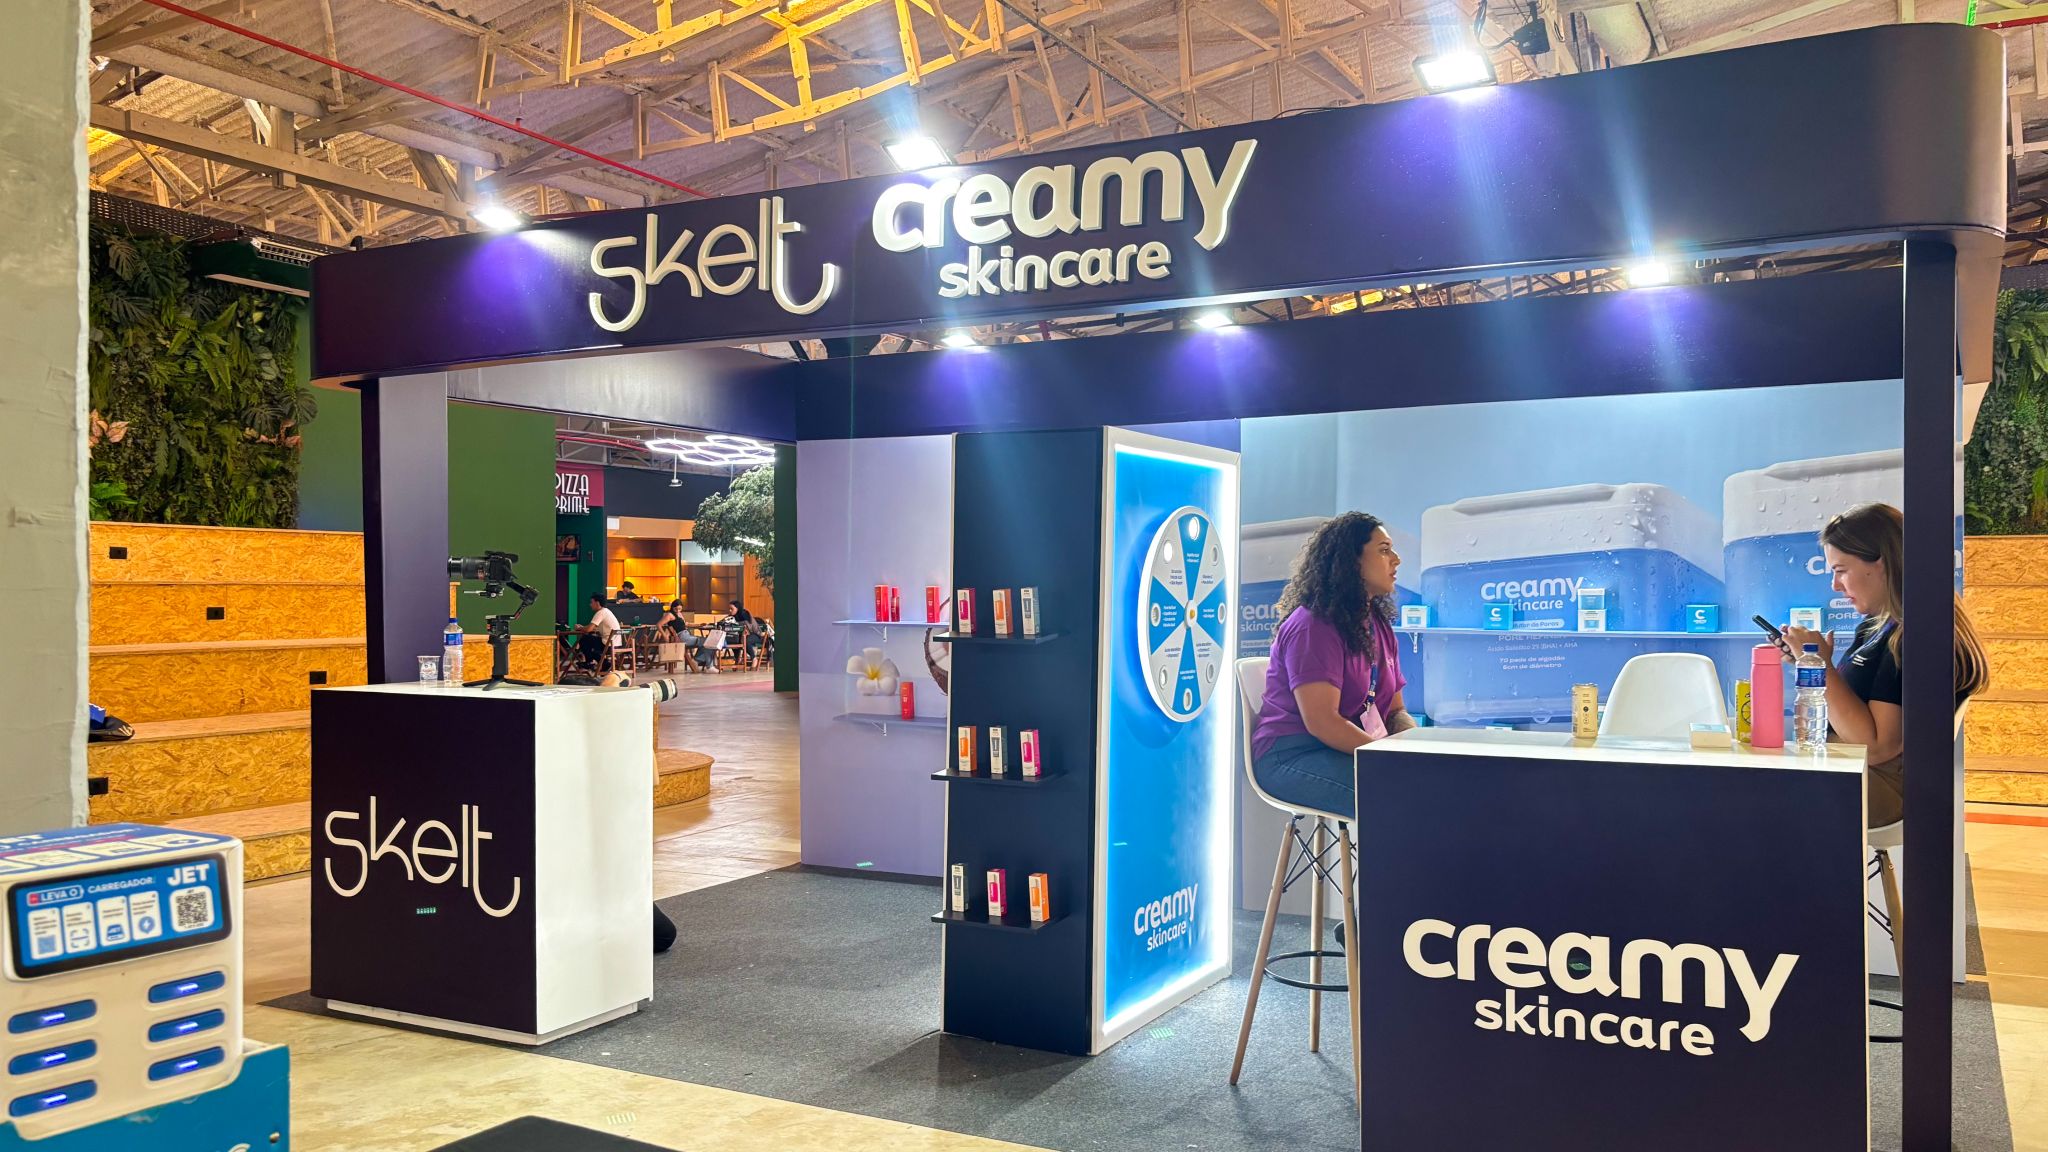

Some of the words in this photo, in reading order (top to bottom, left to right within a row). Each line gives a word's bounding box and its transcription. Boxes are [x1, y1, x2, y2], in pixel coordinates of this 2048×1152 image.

[871, 138, 1258, 254] creamy
[588, 195, 838, 333] skelt
[937, 240, 1172, 299] skincare
[1480, 576, 1584, 603] creamy
[1509, 599, 1564, 612] kincare
[167, 863, 210, 886] JET
[325, 796, 520, 917] skelt
[40, 890, 68, 902] LEVA
[1134, 883, 1198, 936] creamy
[1147, 920, 1187, 951] skincare
[1403, 919, 1799, 1042] creamy
[1474, 989, 1714, 1055] skincare
